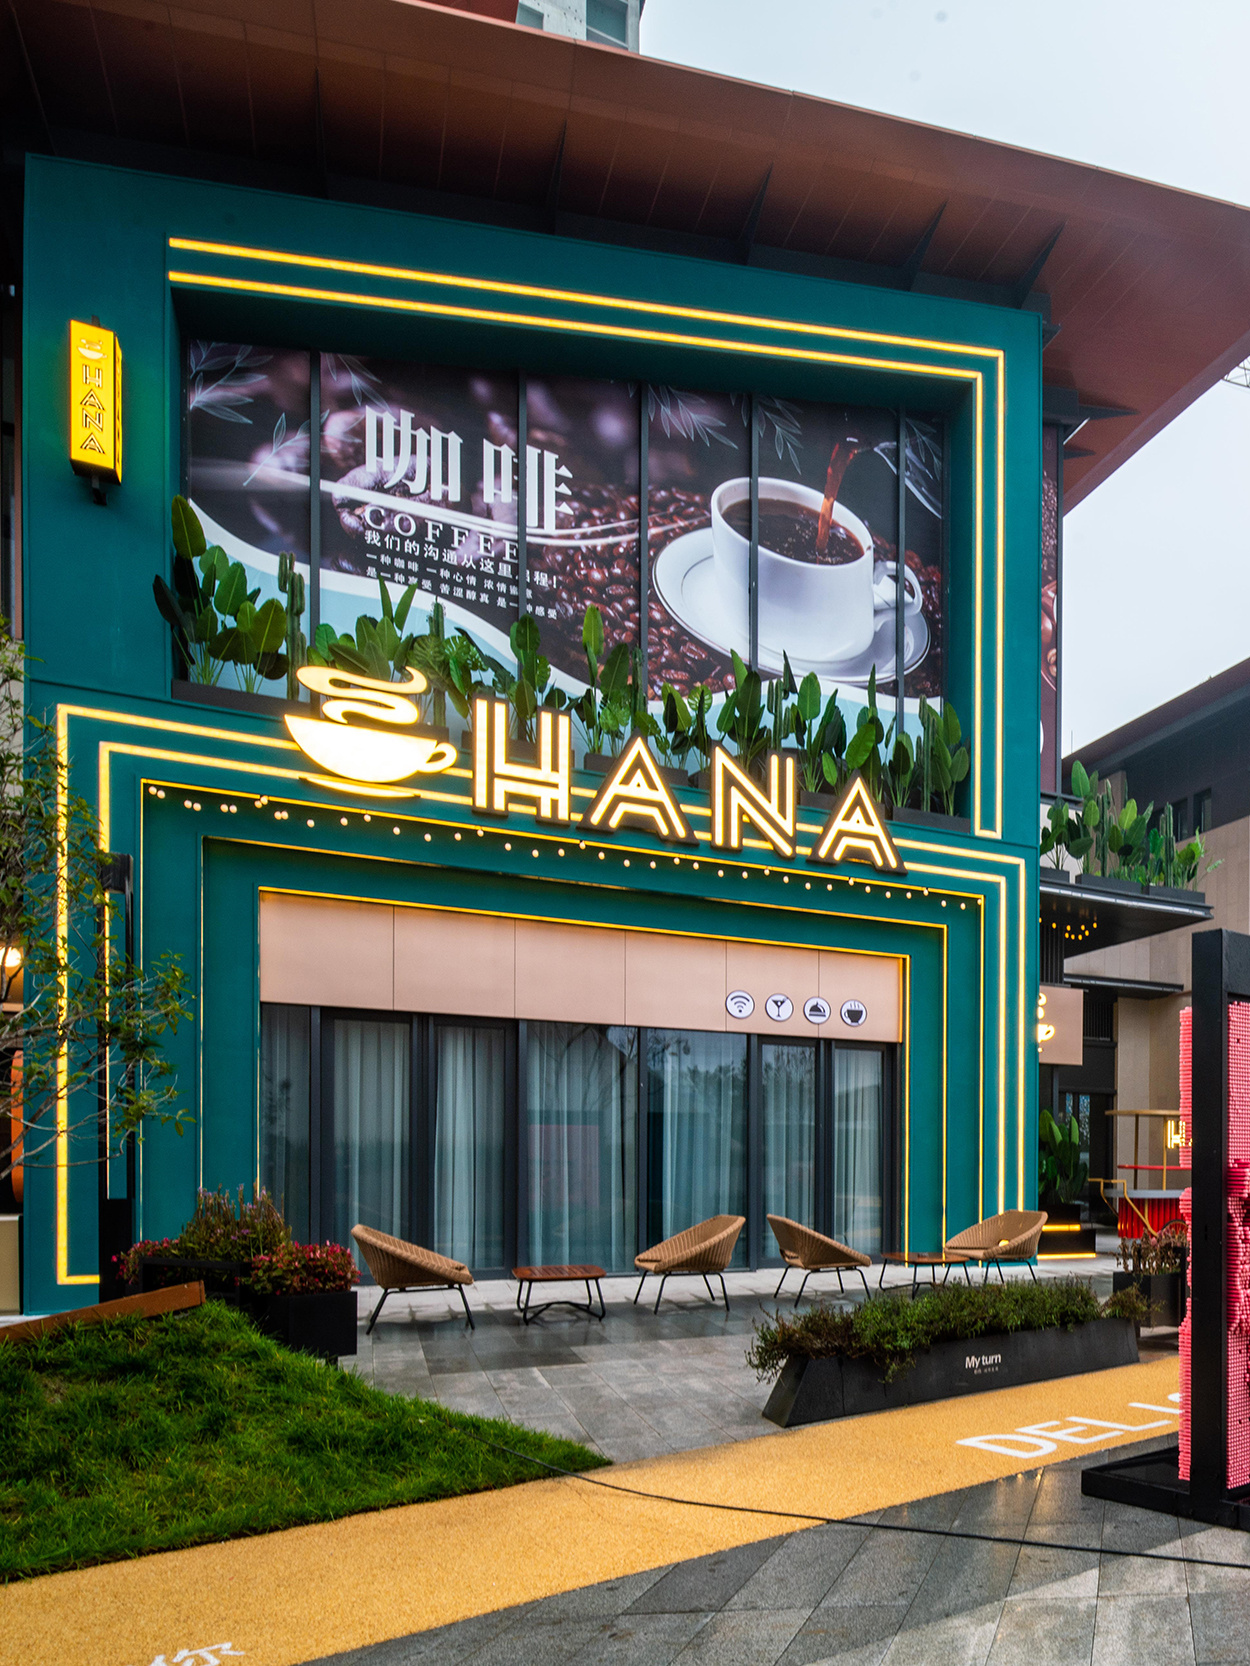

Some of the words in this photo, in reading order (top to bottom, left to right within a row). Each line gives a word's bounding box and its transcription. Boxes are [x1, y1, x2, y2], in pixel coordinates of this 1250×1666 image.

[80, 363, 105, 455] HANA
[365, 405, 575, 531] 咖啡
[365, 504, 518, 563] COFFEE
[426, 567, 477, 586] 一种心情
[474, 698, 905, 873] HANA
[965, 1355, 980, 1369] My
[981, 1353, 1002, 1366] turn
[955, 1392, 1183, 1459] DELI
